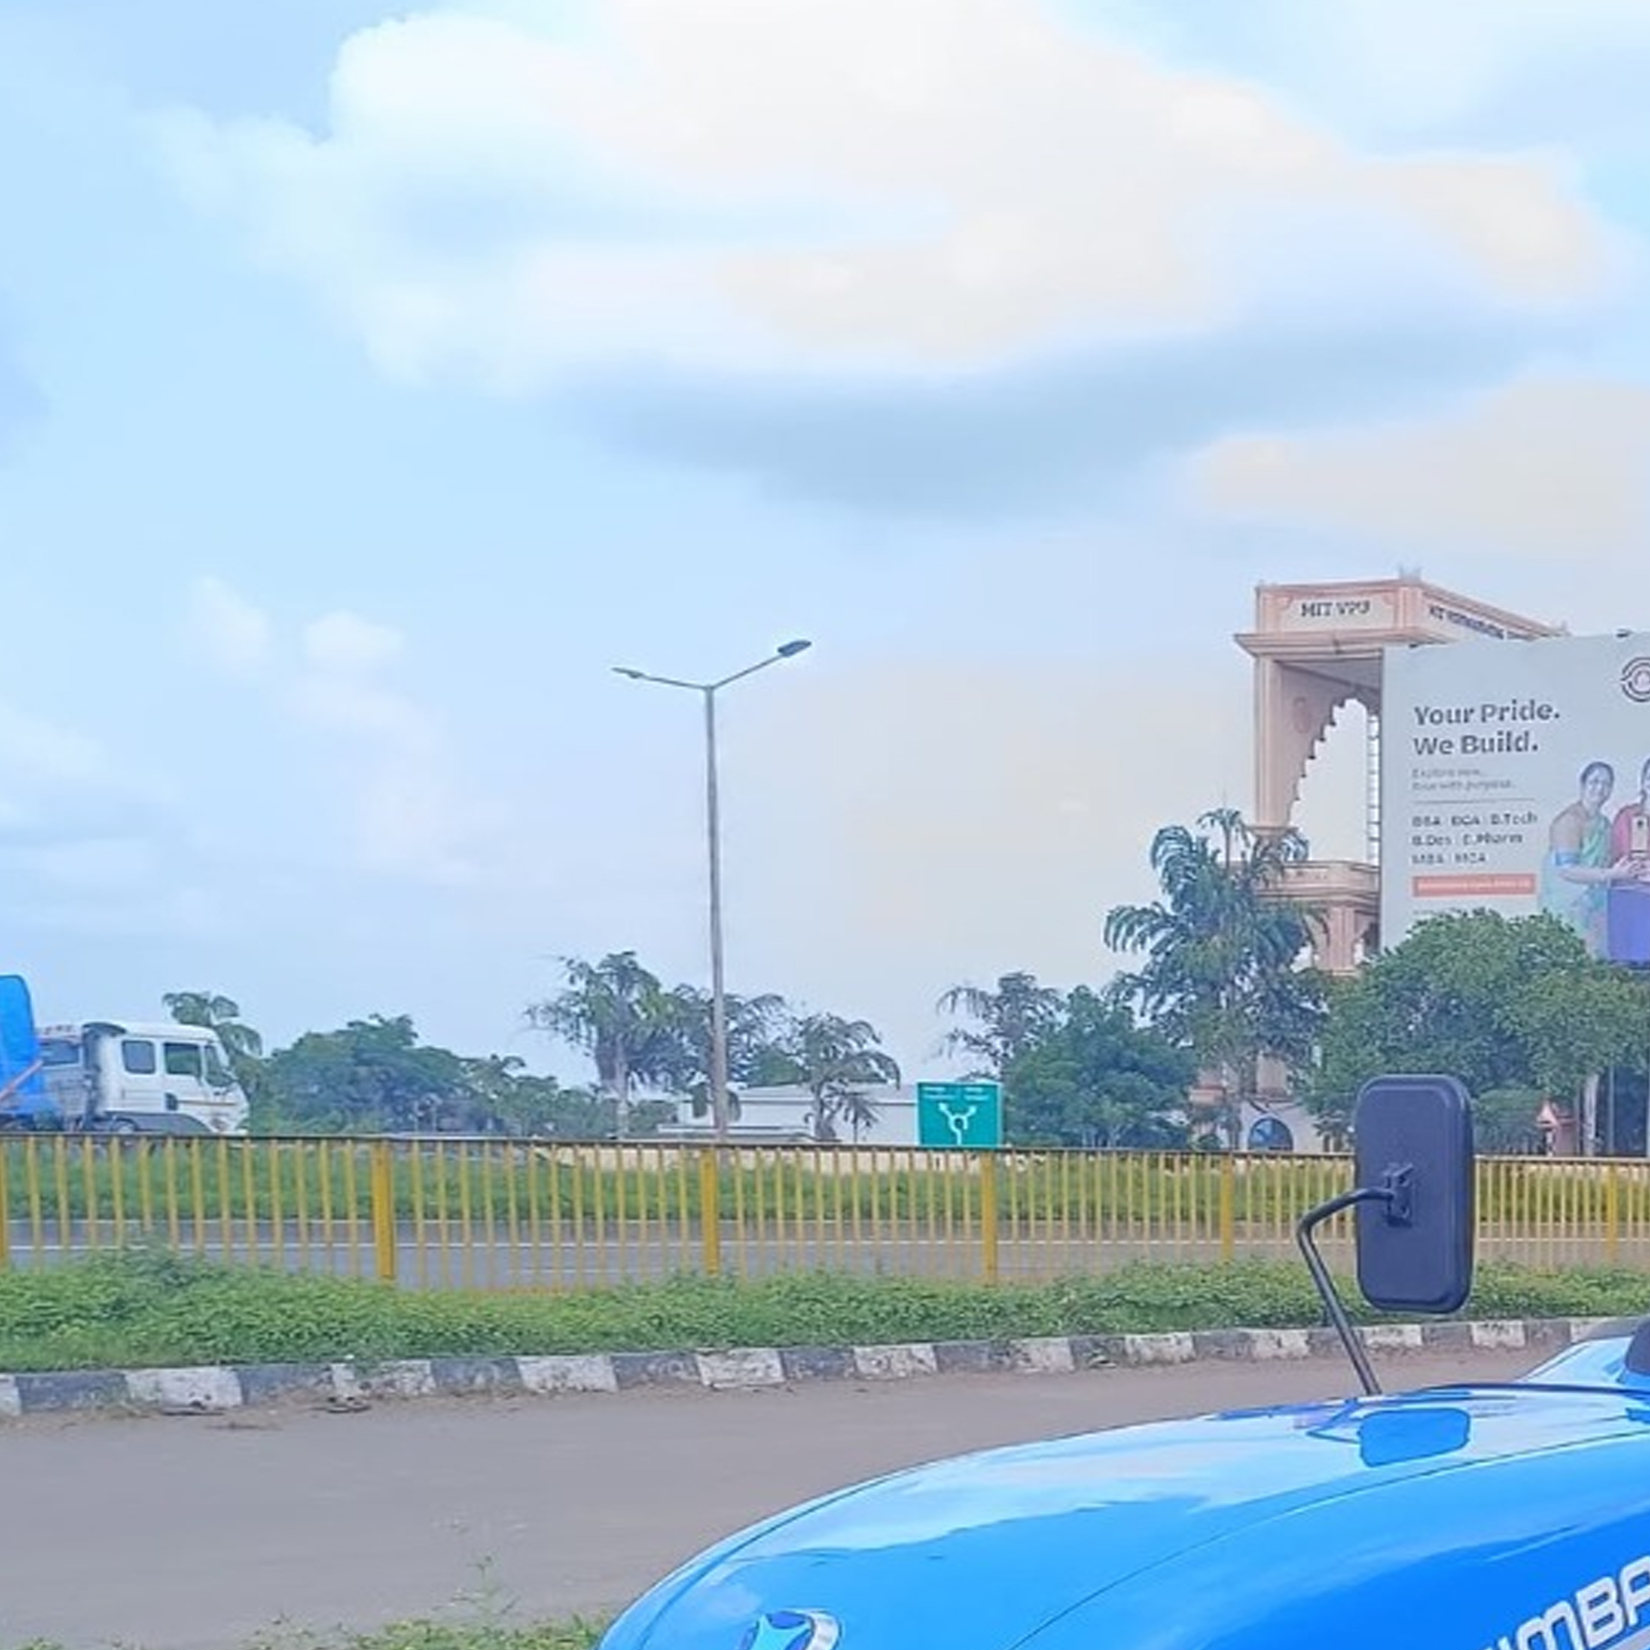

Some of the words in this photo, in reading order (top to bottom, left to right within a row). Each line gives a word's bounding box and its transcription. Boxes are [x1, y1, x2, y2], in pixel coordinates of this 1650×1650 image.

[1301, 603, 1332, 616] MIT
[1413, 705, 1475, 726] Your
[1480, 698, 1560, 723] Pride.
[1413, 737, 1454, 755] We
[1460, 730, 1538, 754] Build.
